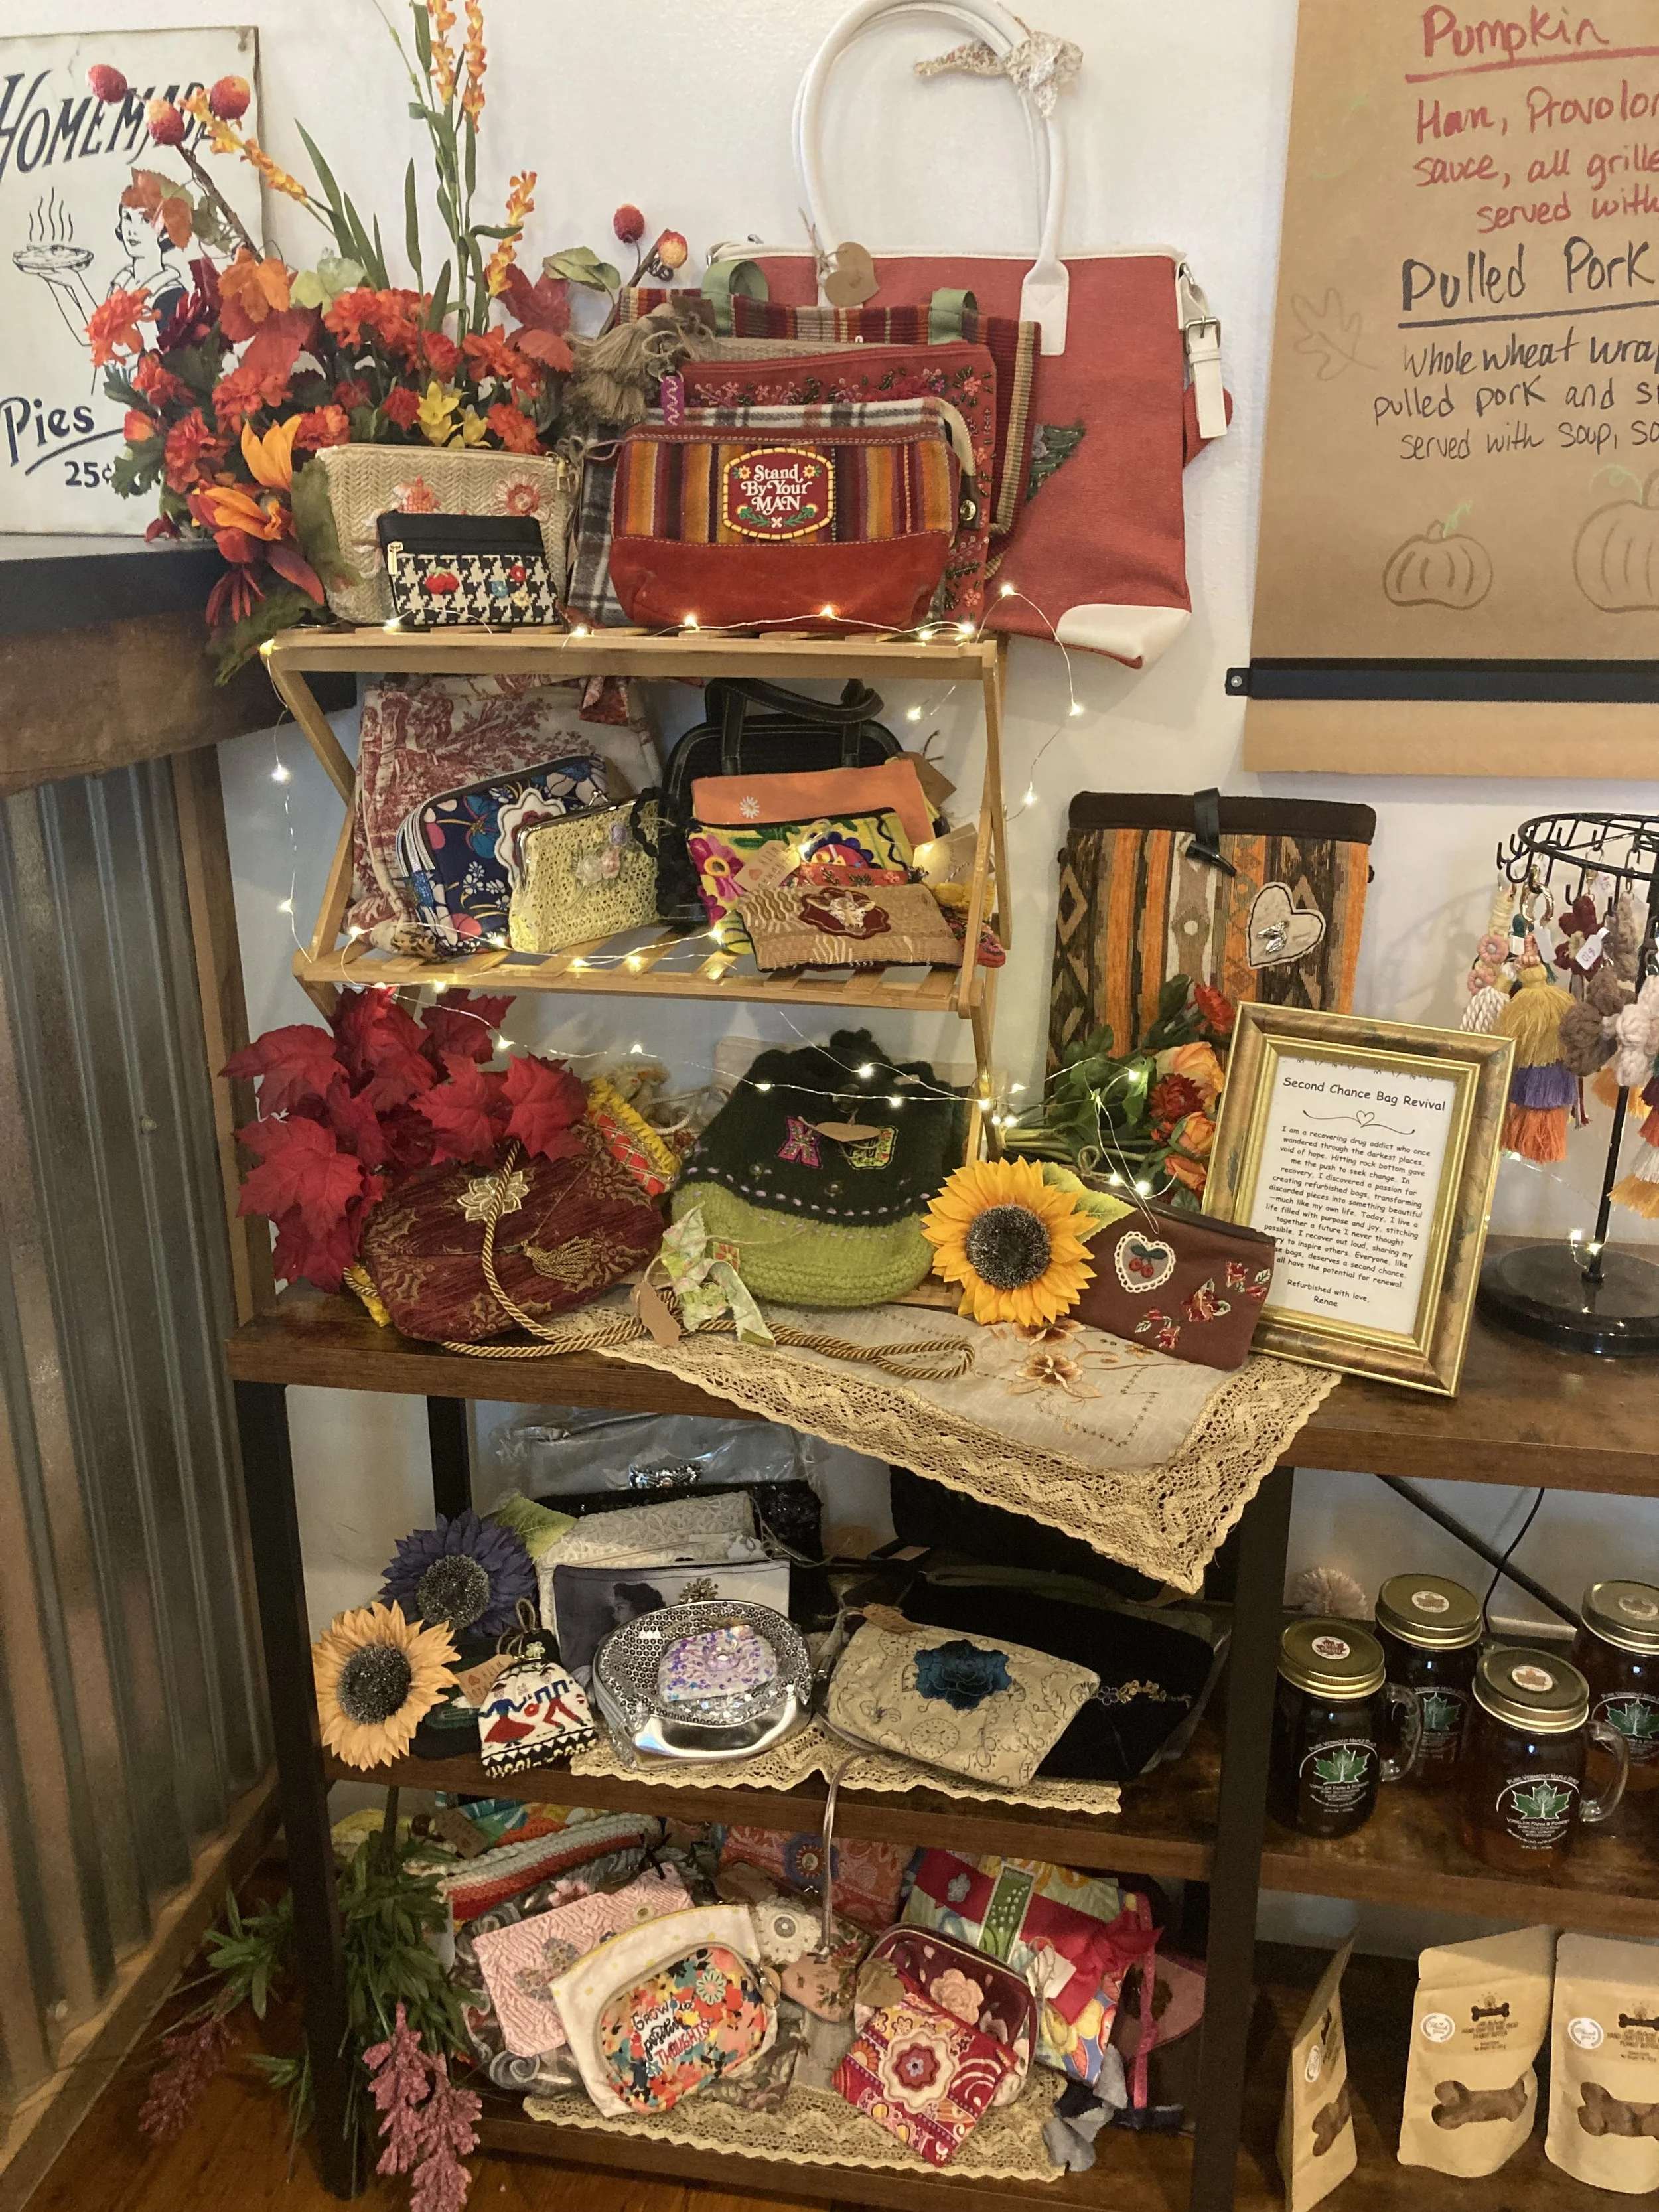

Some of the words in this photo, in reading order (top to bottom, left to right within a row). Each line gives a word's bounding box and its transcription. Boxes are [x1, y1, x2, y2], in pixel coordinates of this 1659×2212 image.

[1421, 5, 1609, 62] Pumpkin
[1417, 99, 1508, 144] Ham,
[1413, 154, 1511, 189] sauce,
[1528, 148, 1571, 183] all
[1477, 190, 1572, 233] served
[1592, 183, 1659, 220] with
[1401, 242, 1526, 311] Pulled
[1563, 236, 1656, 293] Pork
[1589, 336, 1659, 374] wra
[1374, 383, 1455, 427] pulled
[1475, 374, 1546, 419] pork
[1565, 376, 1615, 410] and
[0, 396, 94, 467] Pies
[1400, 428, 1471, 461] served
[1486, 420, 1545, 454] with
[741, 480, 768, 496] By
[766, 479, 813, 495] Your
[754, 463, 803, 482] Stand
[751, 496, 802, 516] MAN
[1283, 1076, 1325, 1092] Second
[1329, 1084, 1371, 1099] Chance
[1376, 1090, 1399, 1106] Bag
[1403, 1094, 1446, 1111] Revival
[1283, 1137, 1319, 1147] wandered
[1321, 1141, 1349, 1153] through
[1352, 1147, 1364, 1155] the
[1366, 1149, 1397, 1161] darkest
[1309, 1131, 1348, 1143] recovering
[1350, 1136, 1367, 1147] drug
[1370, 1141, 1394, 1149] addict
[1304, 1159, 1317, 1167] the
[1331, 1153, 1357, 1166] Hitting
[1378, 1161, 1406, 1173] bottom
[1272, 1175, 1303, 1187] creating
[1304, 1181, 1348, 1194] refurbished
[1374, 1193, 1423, 1209] transforming
[1325, 1173, 1365, 1186] discovered
[1374, 1183, 1402, 1193] passion
[1269, 1183, 1305, 1195] discarded
[1306, 1191, 1329, 1200] pieces
[1332, 1195, 1346, 1203] into
[1348, 1199, 1386, 1213] something
[1388, 1205, 1423, 1218] beautiful
[1297, 1198, 1310, 1207] like
[1312, 1203, 1323, 1211] my
[1398, 1217, 1411, 1226] live
[1265, 1202, 1278, 1211] life
[1281, 1205, 1301, 1215] filled
[1302, 1211, 1319, 1219] with
[1320, 1215, 1349, 1225] purpose
[1386, 1227, 1419, 1240] stitching
[1276, 1215, 1308, 1226] together
[1318, 1222, 1342, 1234] future
[1375, 1234, 1404, 1246] thought
[1297, 1239, 1322, 1250] inspire
[1395, 1258, 1408, 1268] like
[1305, 1232, 1334, 1242] recover
[1372, 1244, 1400, 1257] sharing
[1402, 1251, 1413, 1260] my
[1287, 1258, 1305, 1268] have
[1322, 1266, 1356, 1278] potential
[1358, 1272, 1371, 1281] for
[1307, 1252, 1340, 1264] deserves
[1350, 1262, 1376, 1272] second
[1287, 1278, 1332, 1294] Refurbished
[1313, 1295, 1338, 1307] Renae
[654, 2018, 711, 2065] THOUGHTS
